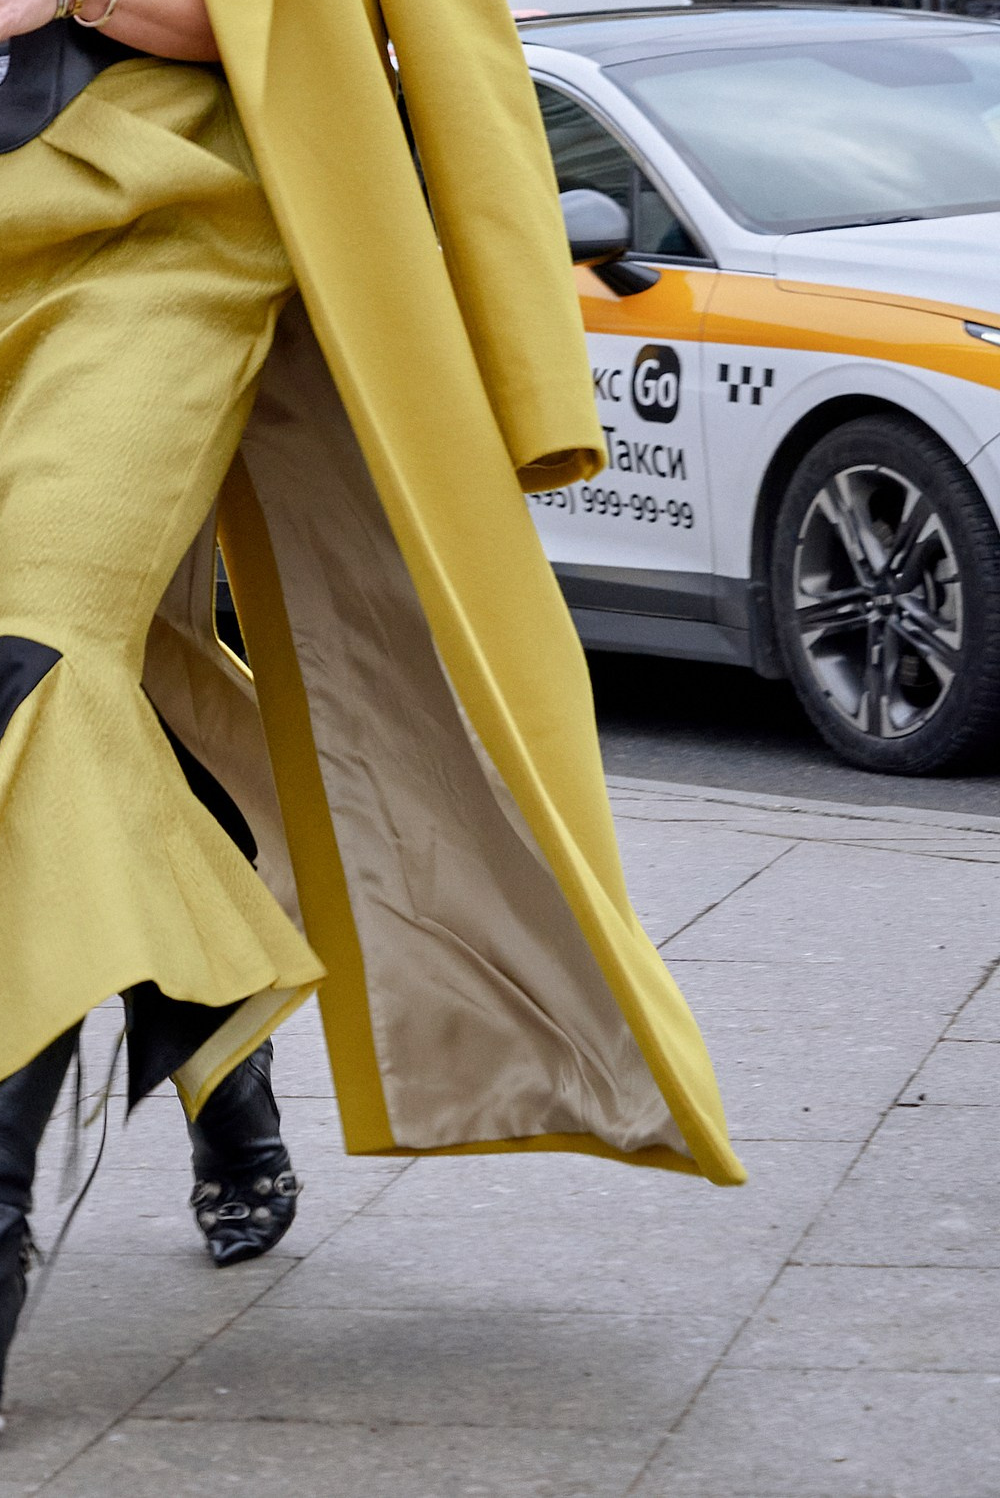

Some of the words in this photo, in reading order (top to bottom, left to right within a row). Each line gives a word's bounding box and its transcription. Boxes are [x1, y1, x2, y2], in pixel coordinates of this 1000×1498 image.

[634, 358, 678, 408] Go
[601, 425, 687, 481] Такси
[581, 486, 694, 529] 999-99-99
